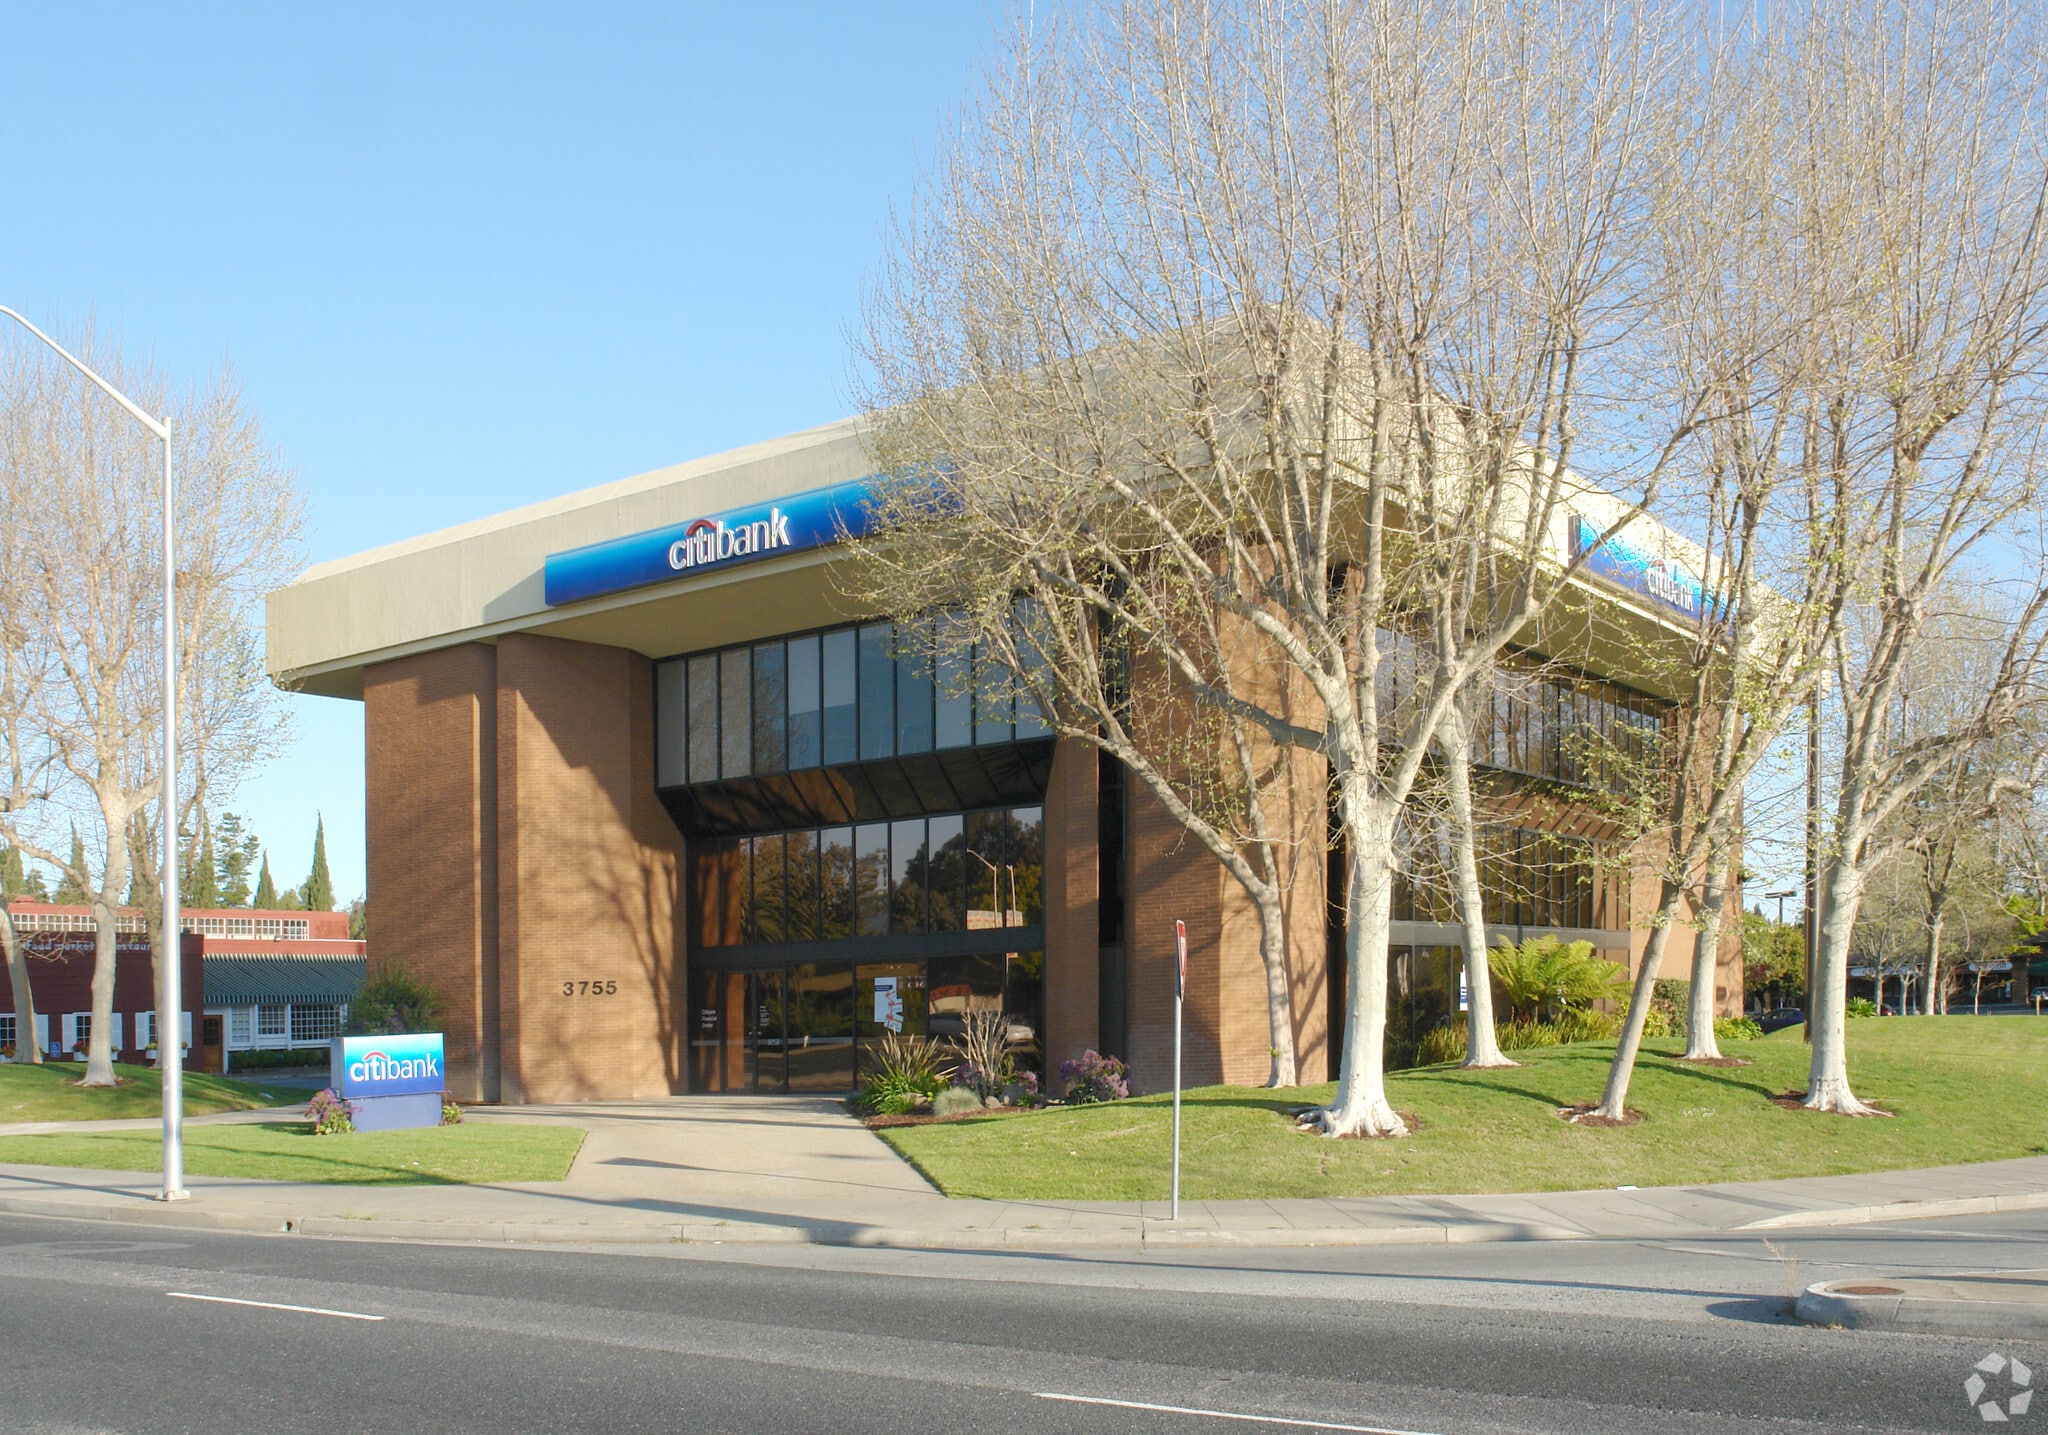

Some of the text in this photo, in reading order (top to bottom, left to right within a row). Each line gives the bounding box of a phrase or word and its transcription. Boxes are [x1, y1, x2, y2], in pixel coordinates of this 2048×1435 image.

[668, 507, 790, 570] citibank
[115, 941, 151, 951] estaur
[562, 980, 618, 996] 3755
[350, 1051, 439, 1082] citibank
